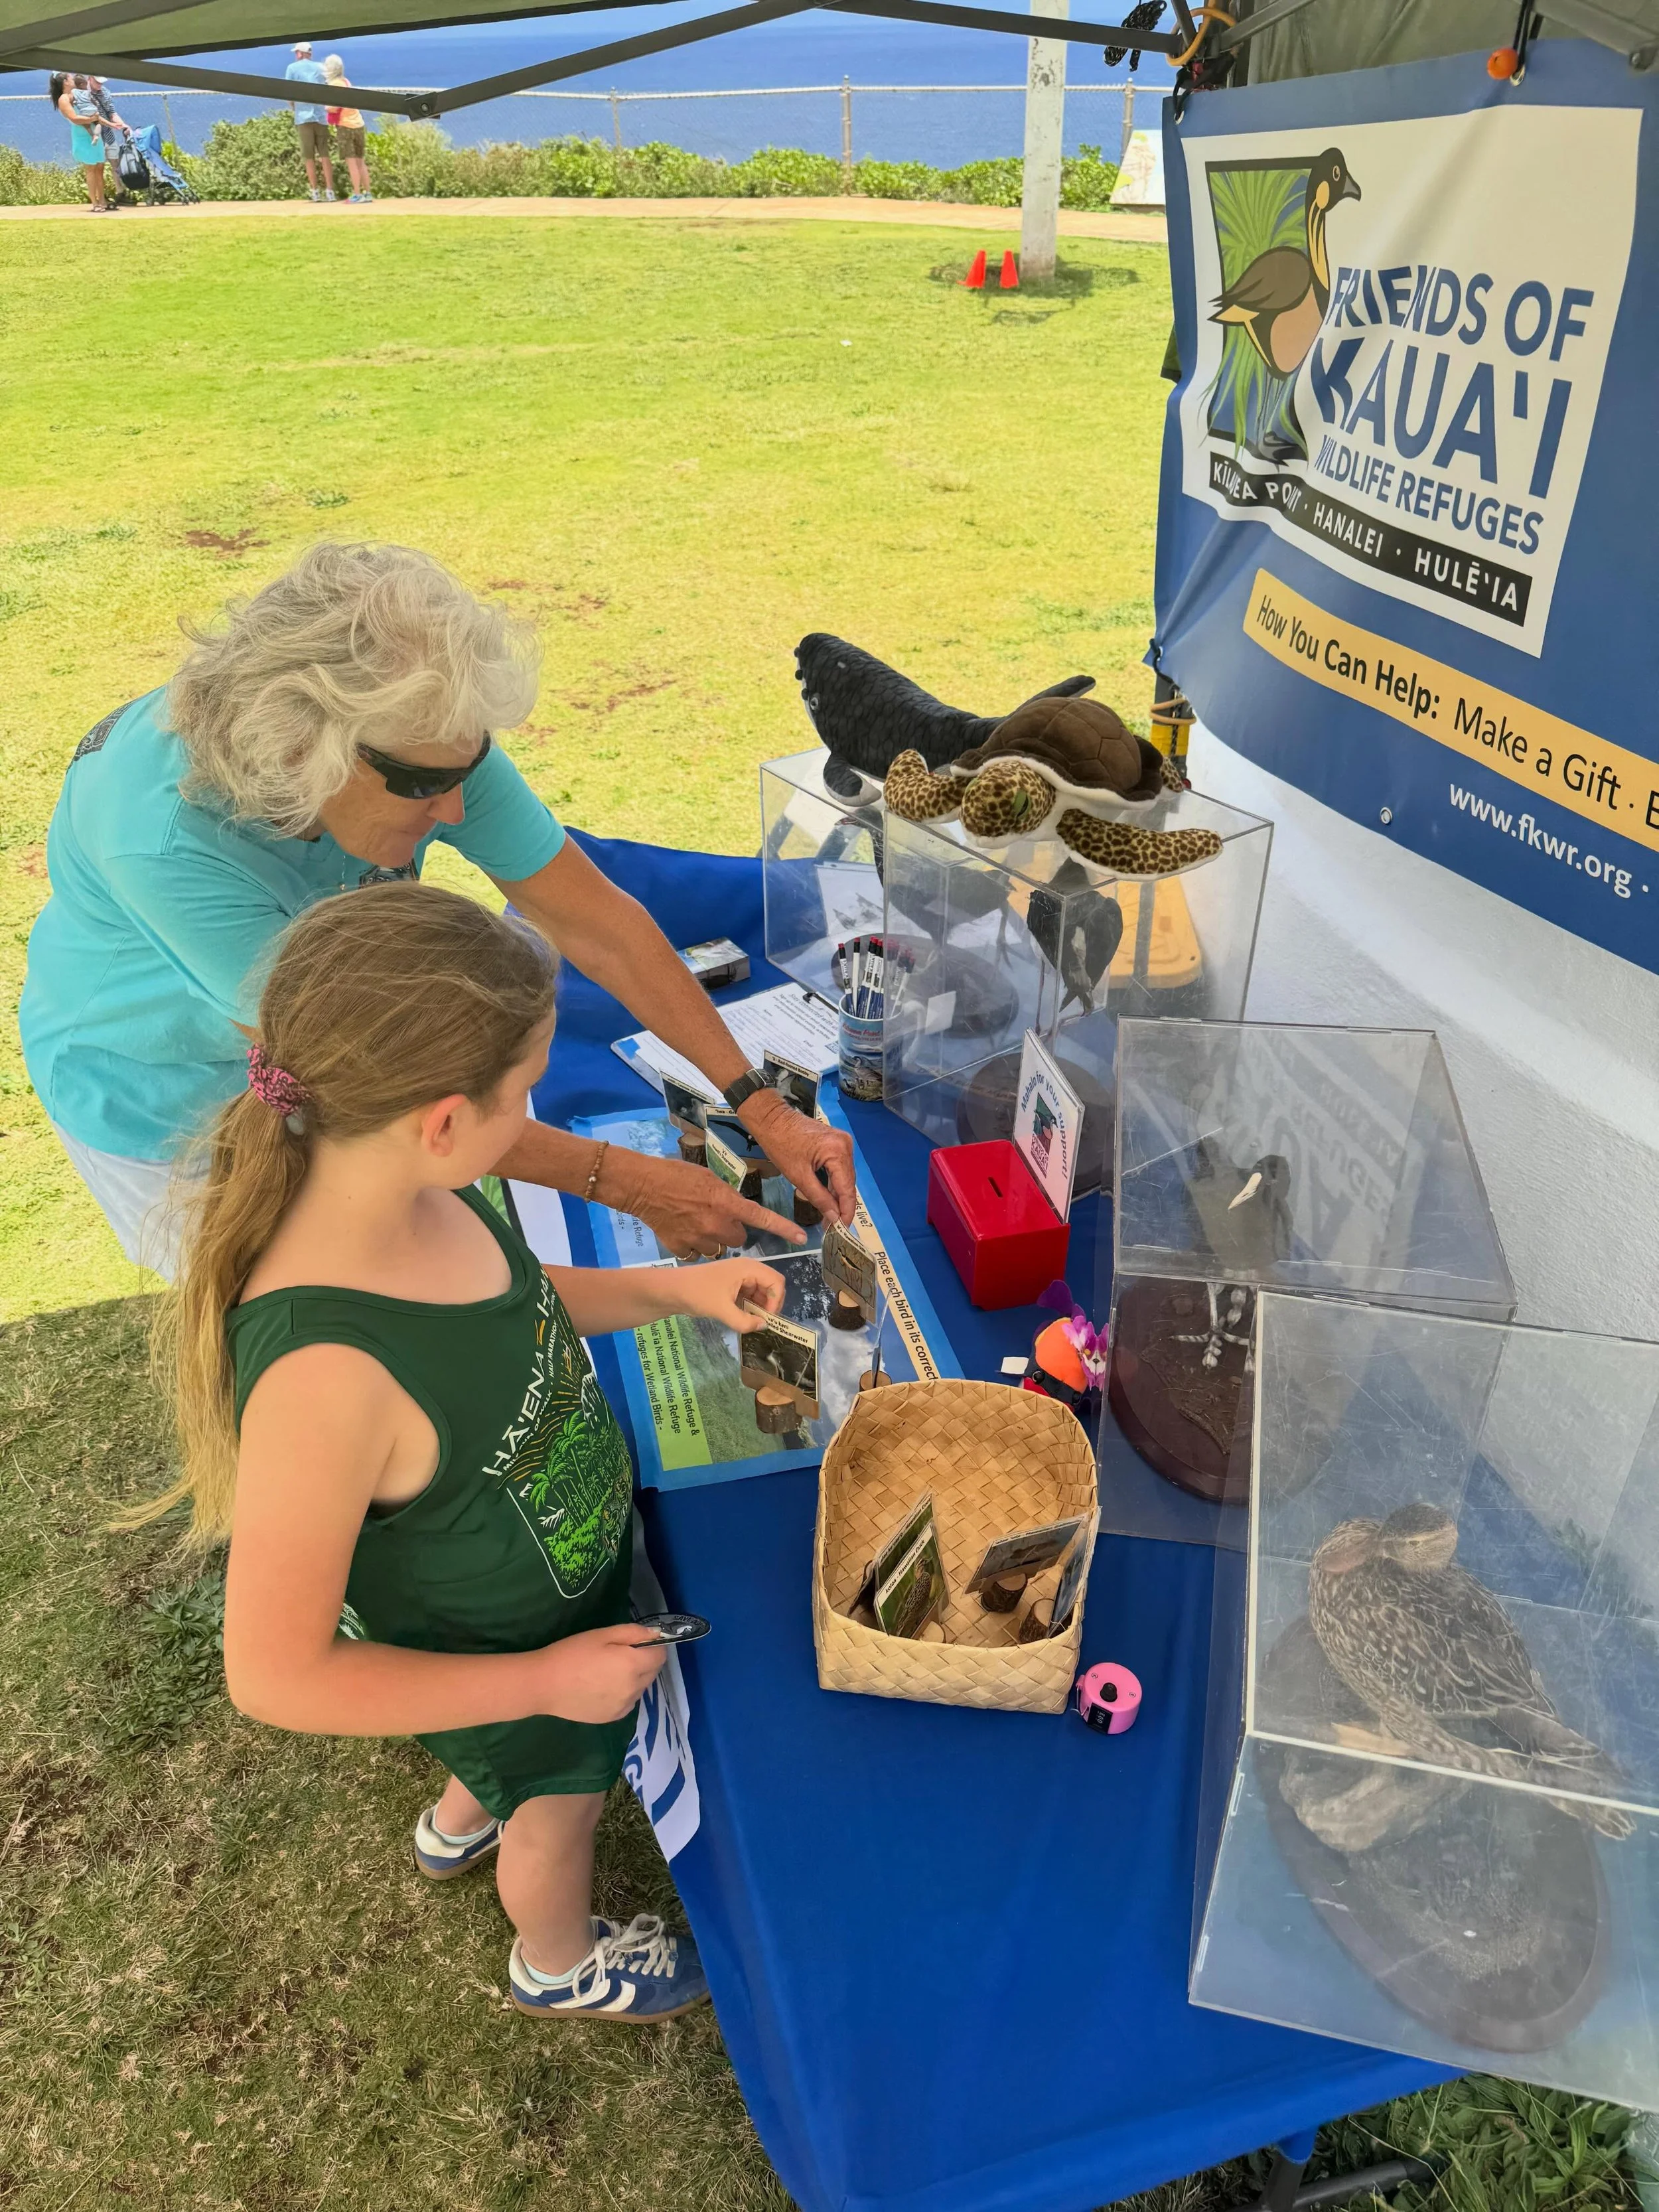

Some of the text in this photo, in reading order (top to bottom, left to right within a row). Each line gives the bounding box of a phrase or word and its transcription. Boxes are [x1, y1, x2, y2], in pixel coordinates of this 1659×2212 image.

[1325, 265, 1594, 362] FRIENDS OF
[1315, 435, 1544, 554] WILDLIFE REFUGES
[1313, 502, 1383, 557] HANALEI
[1257, 595, 1287, 639] How
[1289, 616, 1319, 661] You
[1325, 639, 1366, 684] Can
[1375, 660, 1440, 719] Help:
[1454, 698, 1527, 763] Make
[1536, 748, 1552, 777] a
[1563, 753, 1621, 810] Gift
[1450, 784, 1632, 898] www.fkwr.org
[1021, 1070, 1068, 1179] Mahalo for your support!
[857, 1211, 873, 1228] live?
[634, 1225, 644, 1247] Refuge
[875, 1252, 938, 1380] Place each bird in its correct
[636, 1333, 650, 1360] refuges
[779, 1327, 808, 1343] Shearwater
[642, 1359, 652, 1371] for
[654, 1345, 669, 1376] National
[668, 1340, 684, 1370] National
[644, 1372, 660, 1404] Wetland
[662, 1376, 676, 1403] Wildlife
[676, 1371, 690, 1397] Wildlife
[519, 1432, 534, 1450] UN
[534, 1418, 541, 1432] OR
[539, 1389, 553, 1416] WALK
[652, 1404, 664, 1425] Birds
[666, 1404, 684, 1434] Refuge
[681, 1398, 698, 1428] Refuge
[885, 1580, 897, 1594] koloa
[899, 1552, 916, 1577] Hawaiian
[915, 1539, 926, 1556] Duck
